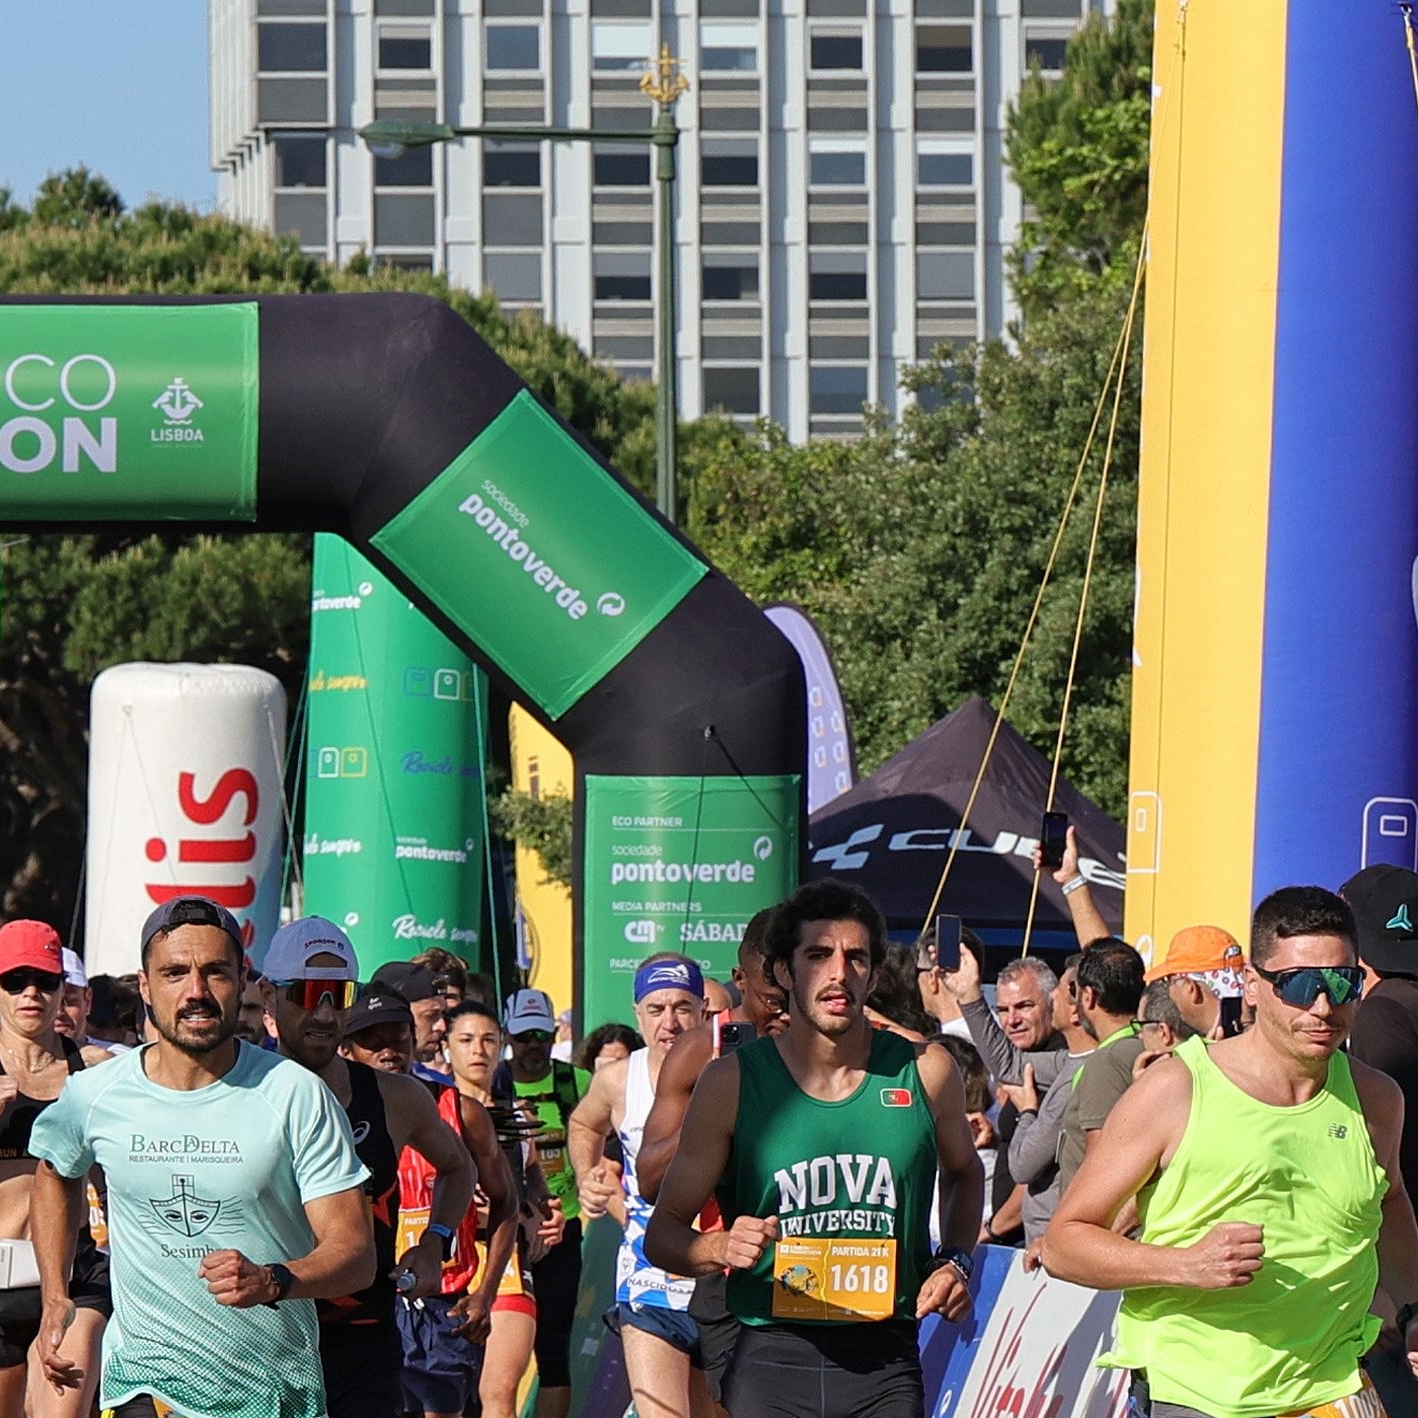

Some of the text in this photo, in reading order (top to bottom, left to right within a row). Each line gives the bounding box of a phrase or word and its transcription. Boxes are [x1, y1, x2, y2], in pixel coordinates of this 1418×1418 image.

[150, 428, 205, 442] LISBOA
[458, 493, 589, 620] pontoverde
[611, 815, 683, 827] ECO PARTNER
[145, 767, 259, 912] lis
[611, 859, 756, 885] pontoverde
[129, 1154, 185, 1163] RESTAURANTE
[773, 1153, 898, 1214] NOVA
[779, 1208, 896, 1239] UNIVERSITY
[831, 1246, 869, 1257] PARTIDA
[831, 1264, 889, 1294] 1618
